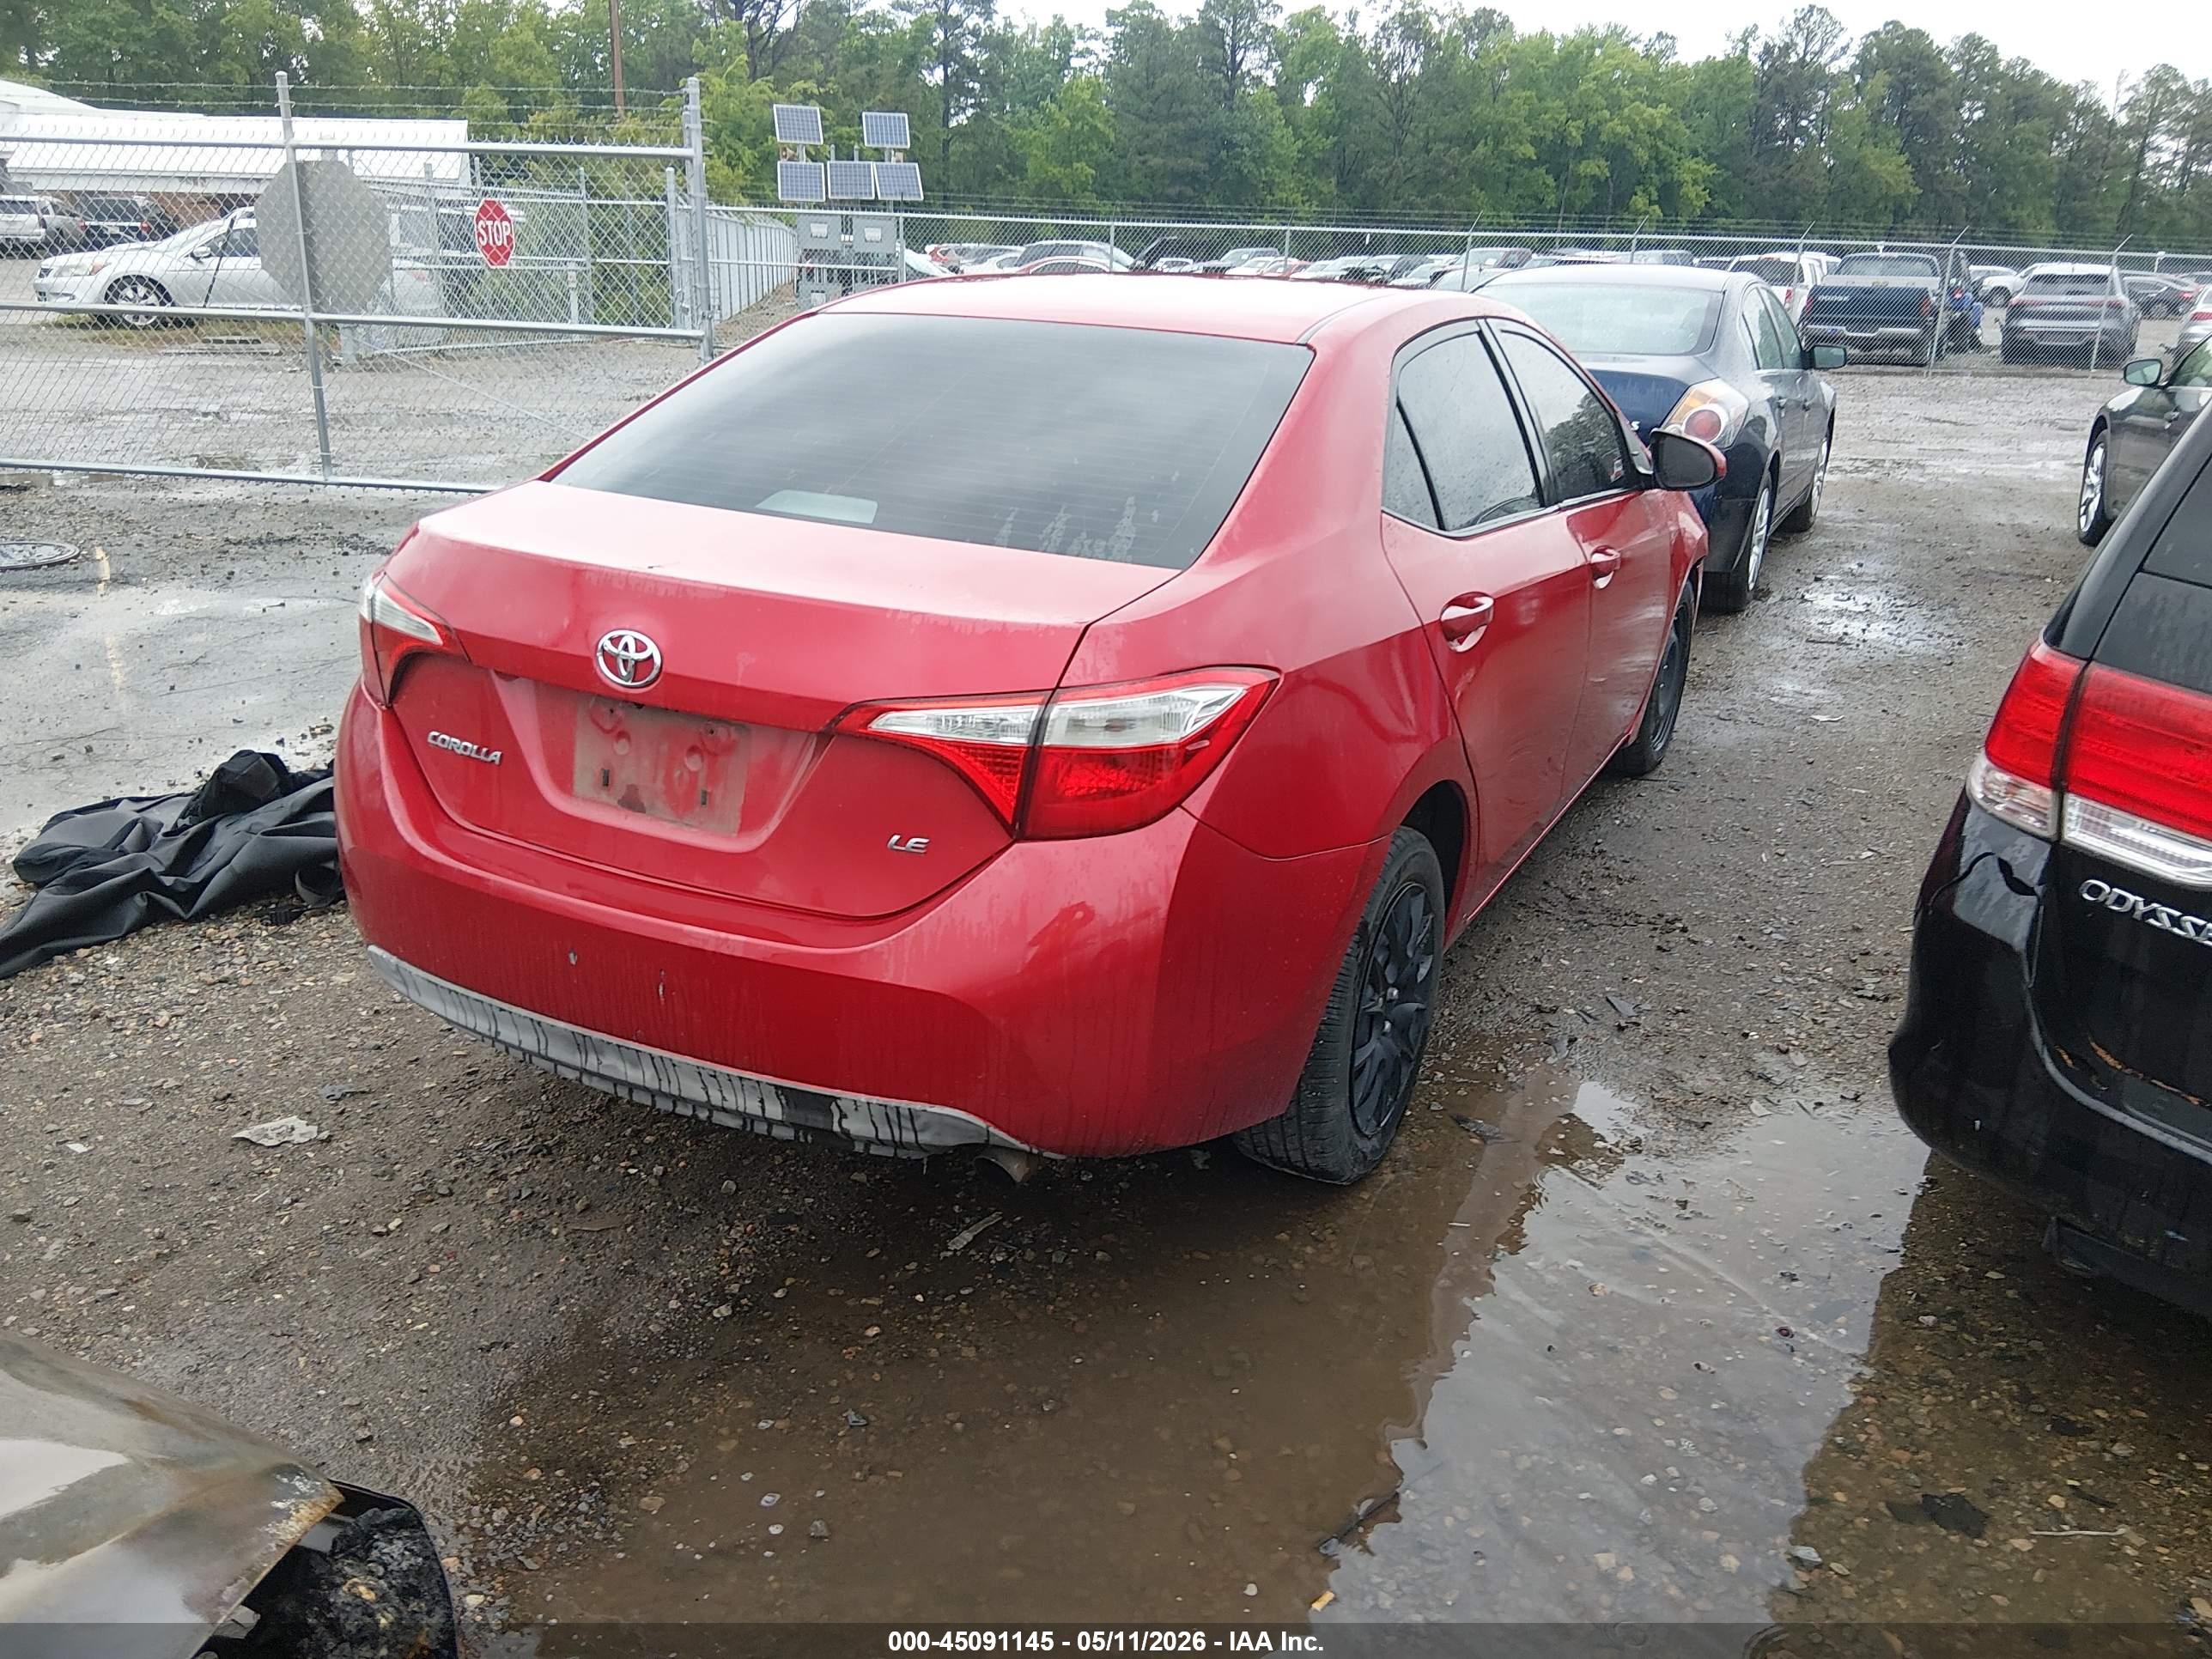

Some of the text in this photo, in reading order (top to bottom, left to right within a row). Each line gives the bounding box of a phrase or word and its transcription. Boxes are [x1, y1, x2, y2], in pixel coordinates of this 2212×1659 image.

[477, 219, 511, 248] STOP
[427, 731, 502, 765] COROLLA
[887, 834, 930, 854] LE
